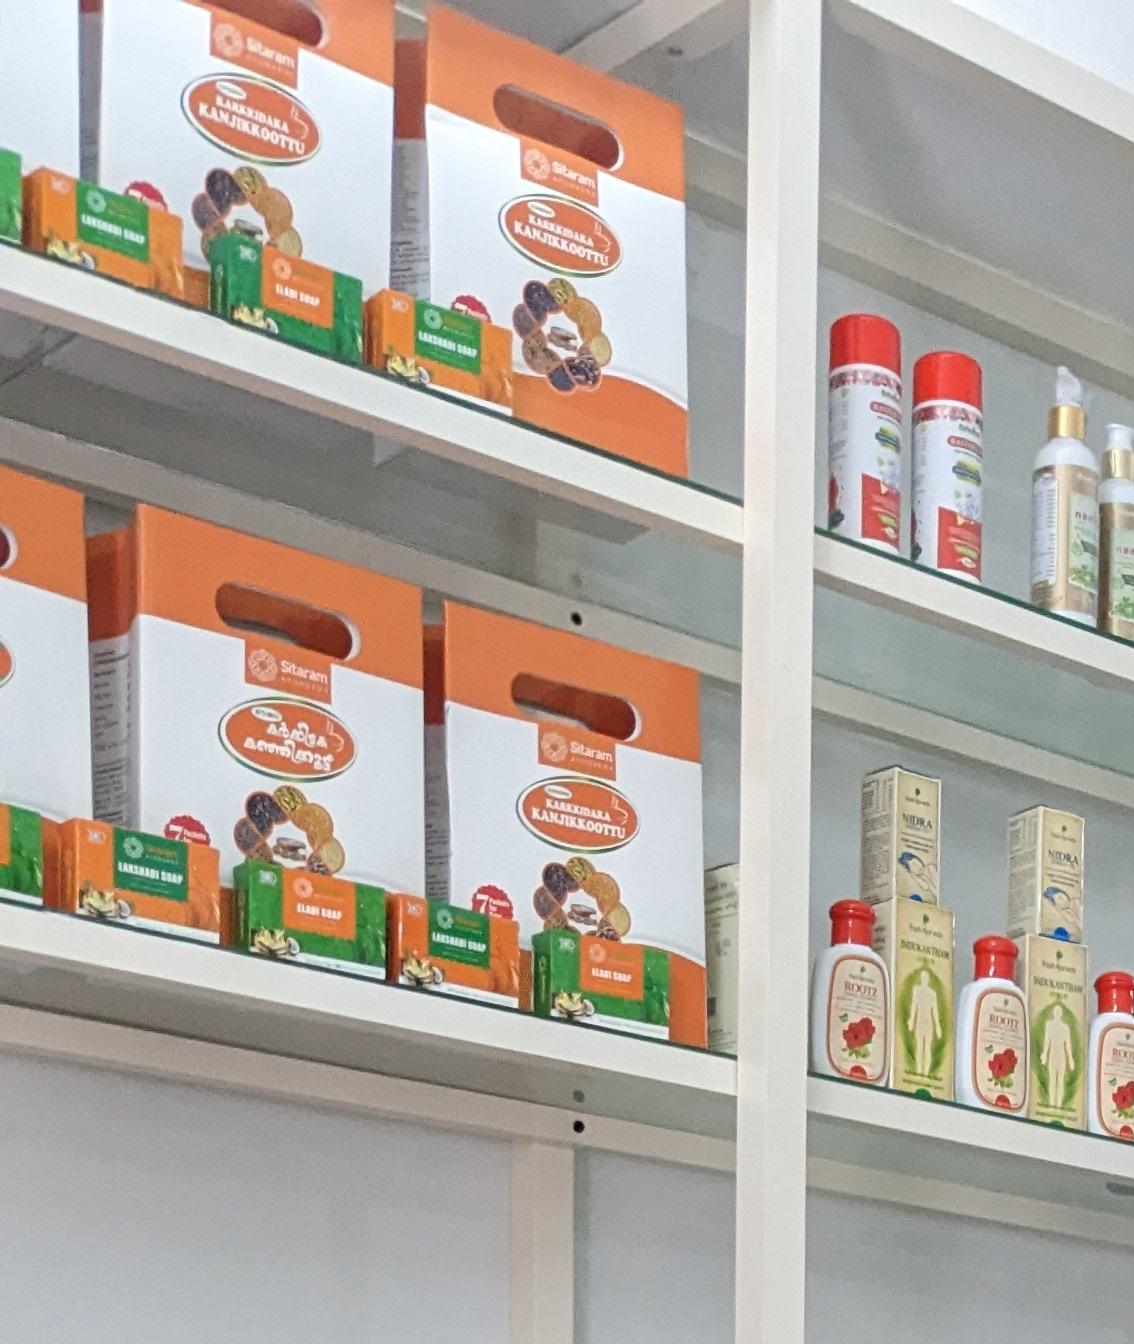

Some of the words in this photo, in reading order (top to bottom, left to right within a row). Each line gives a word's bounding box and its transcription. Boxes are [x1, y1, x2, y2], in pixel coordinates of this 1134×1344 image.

[198, 102, 305, 155] KANJIKKOOTTU
[514, 220, 609, 266] KANJIKKOOTTU
[281, 659, 328, 685] Sitaram
[570, 741, 613, 763] Sitaram
[532, 806, 626, 839] KANJIKKOOTTU
[902, 812, 933, 830] NIDRA
[1047, 848, 1079, 866] NIDRA
[844, 981, 878, 998] ROOTZ
[989, 1013, 1019, 1030] ROOTZ
